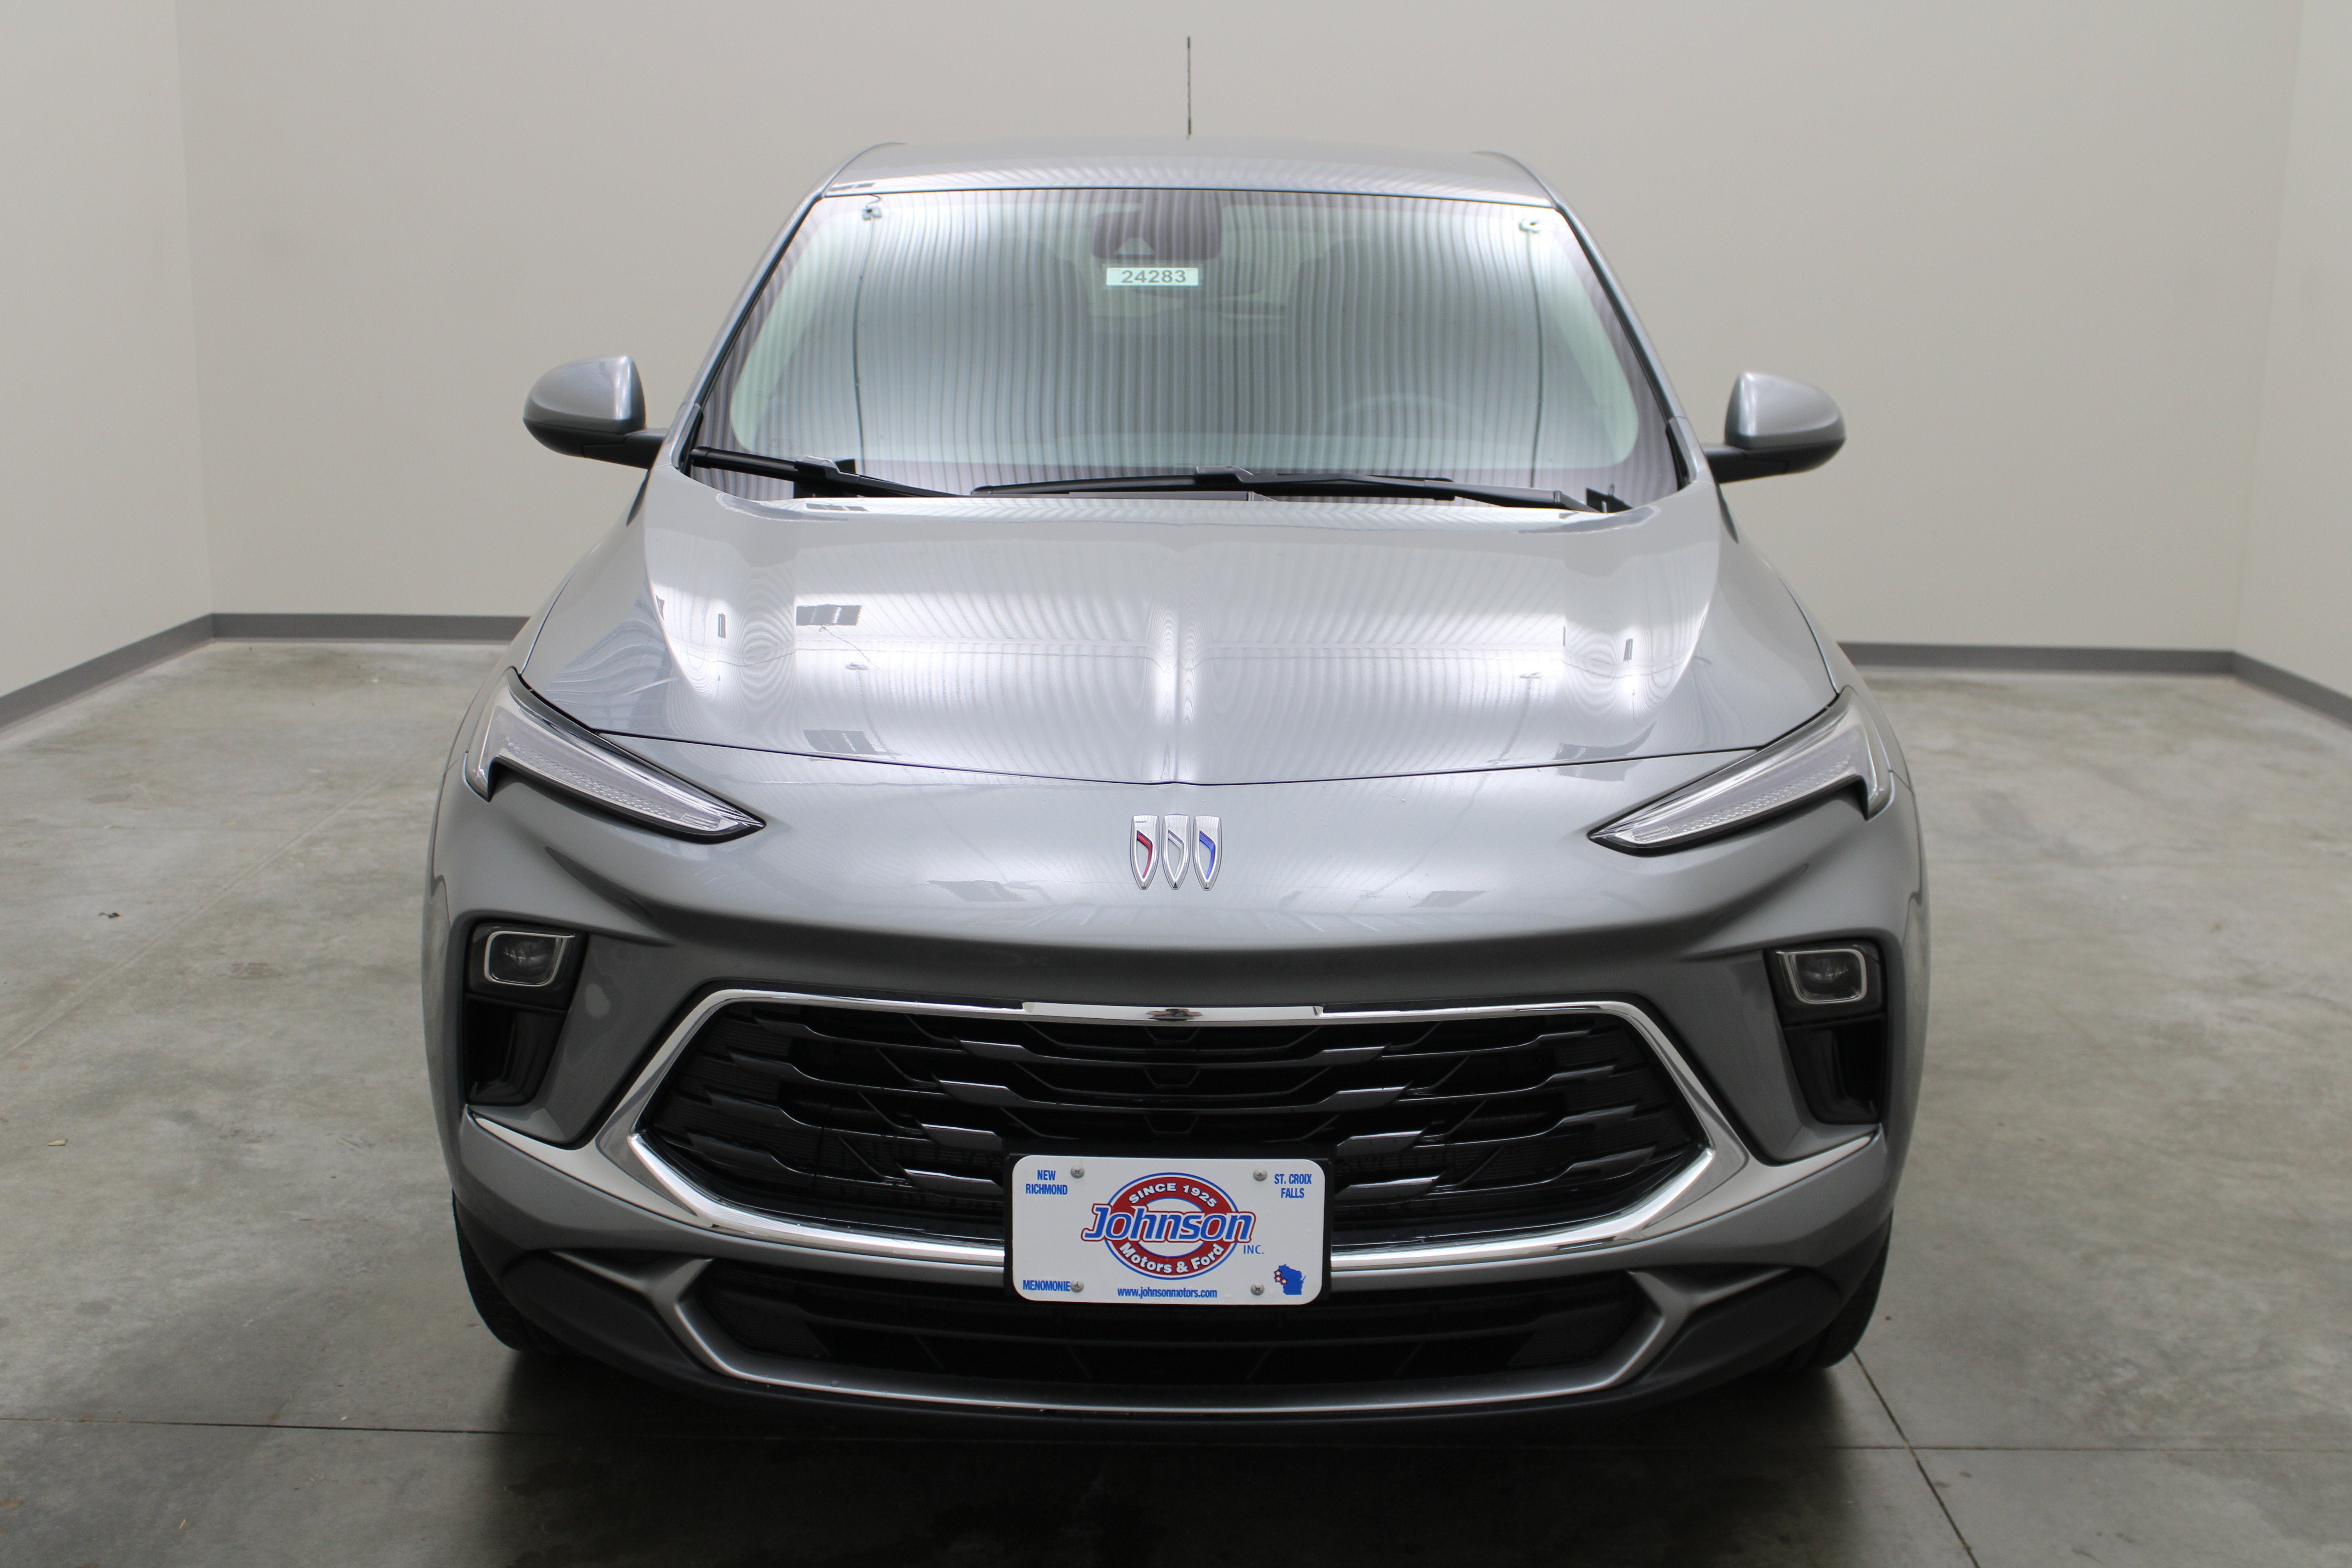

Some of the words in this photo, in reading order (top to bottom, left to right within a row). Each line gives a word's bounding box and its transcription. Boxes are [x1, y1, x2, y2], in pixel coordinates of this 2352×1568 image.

[1121, 270, 1186, 283] 24283
[1037, 1170, 1055, 1180] NEW
[1274, 1174, 1287, 1184] ST.
[1289, 1174, 1312, 1184] CROIX
[1026, 1183, 1067, 1195] RICHMOND
[1129, 1183, 1176, 1204] SINCE
[1183, 1184, 1216, 1207] 1925
[1281, 1188, 1304, 1198] FALLS
[1084, 1205, 1254, 1241] Johnson
[1243, 1245, 1264, 1254] INC.
[1119, 1243, 1172, 1273] Motors
[1176, 1261, 1189, 1273] &
[1191, 1243, 1224, 1271] Ford
[1023, 1280, 1070, 1292] MENOMONIE
[1118, 1287, 1217, 1298] www.johnsonmotors.com
